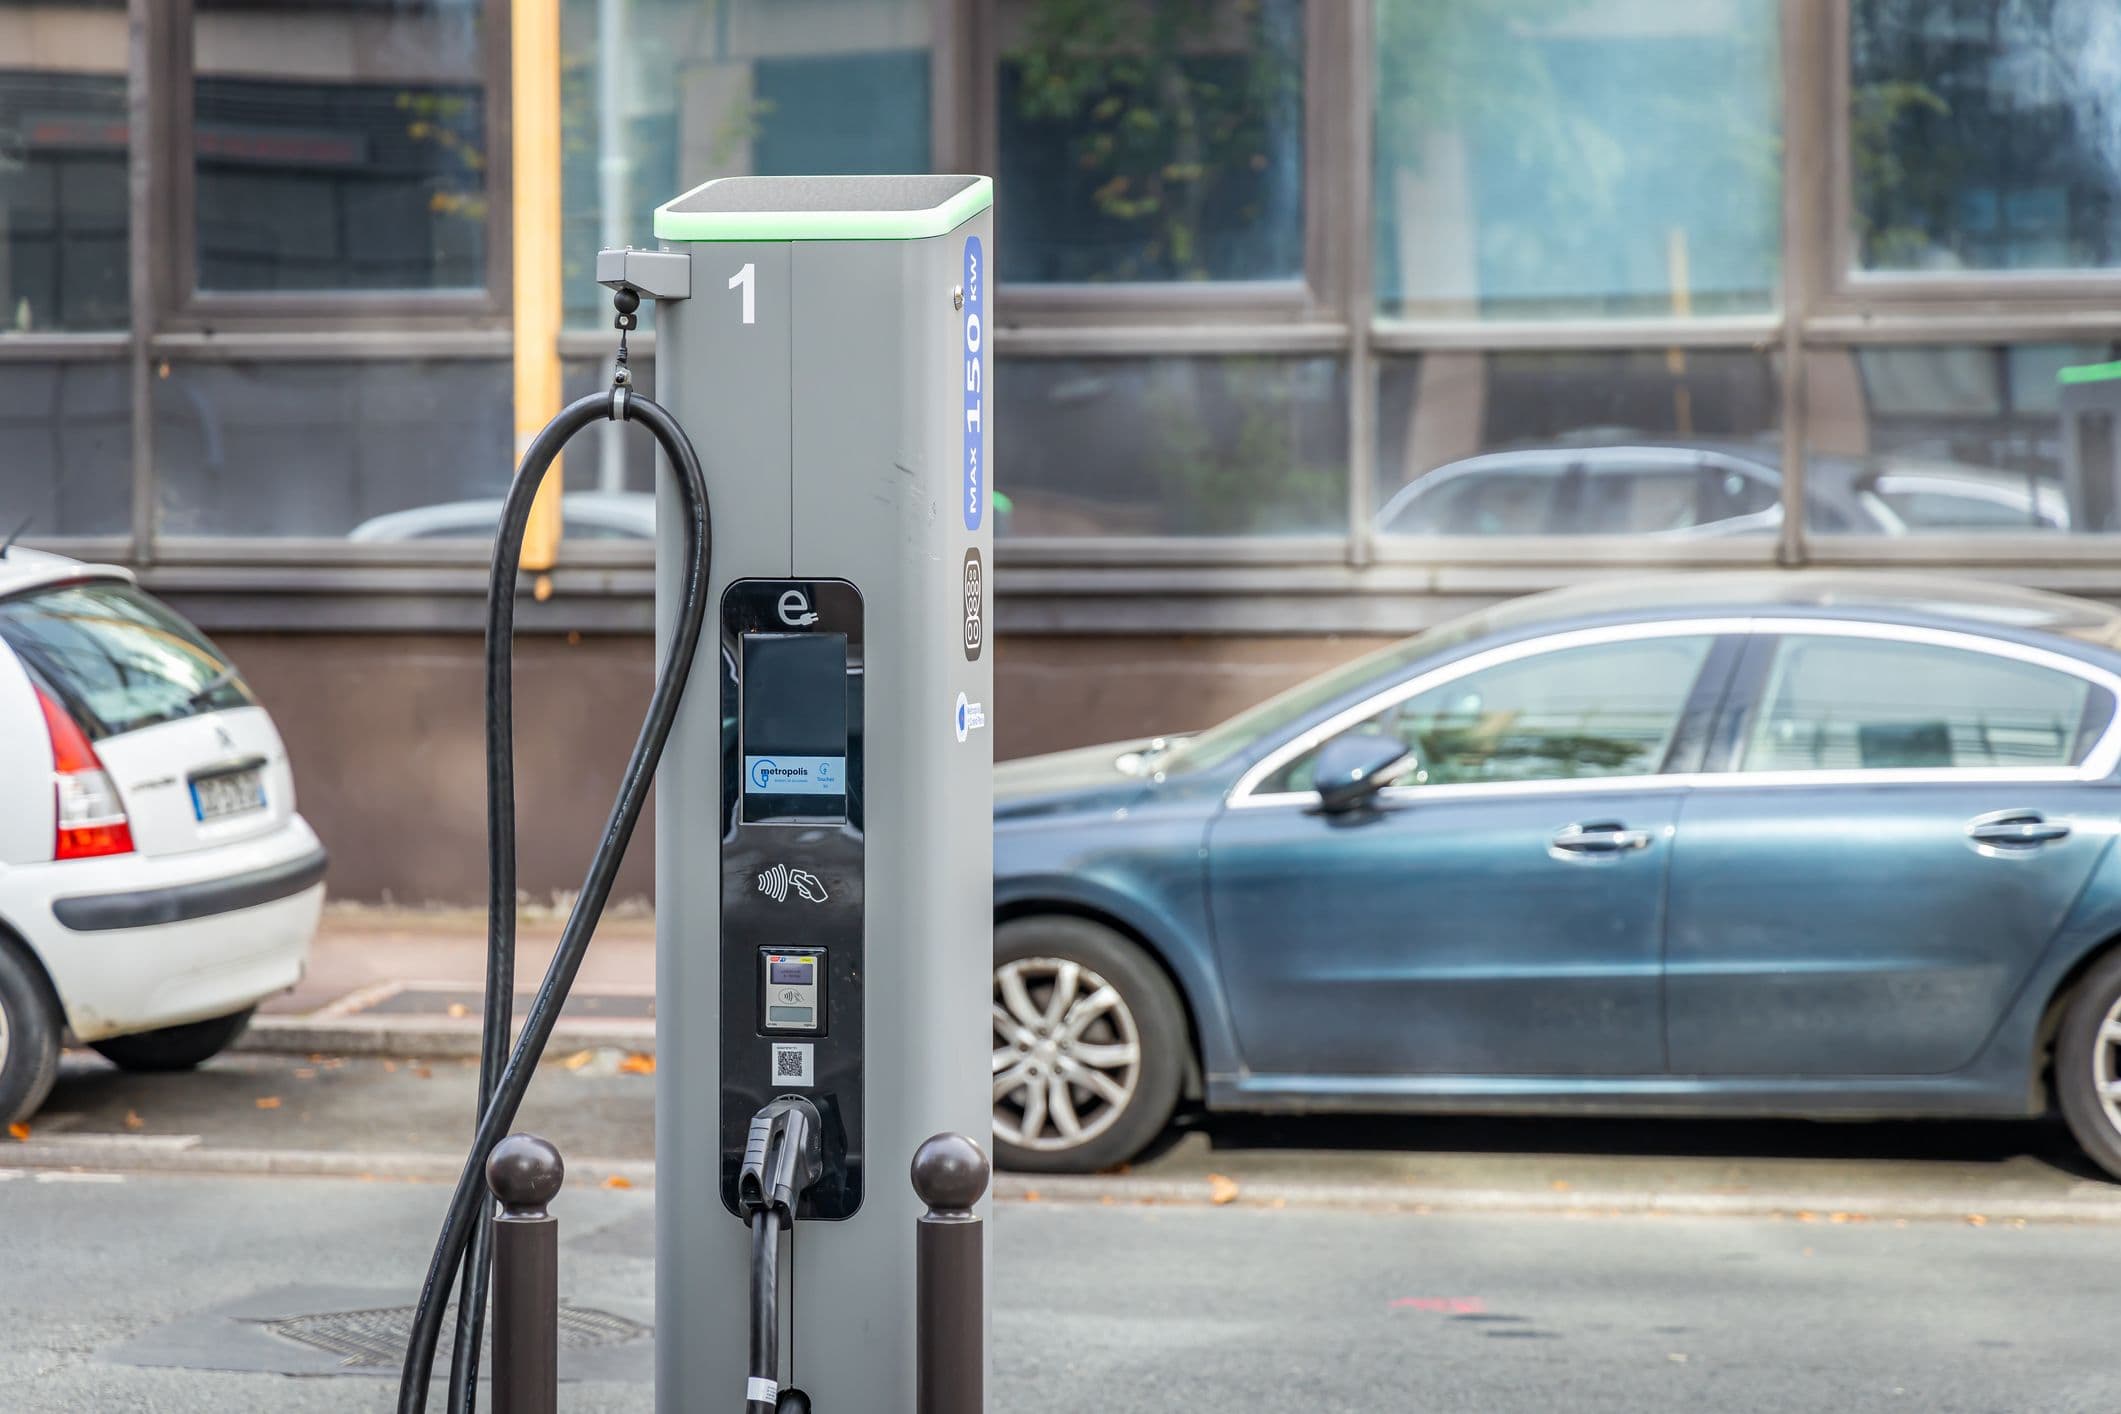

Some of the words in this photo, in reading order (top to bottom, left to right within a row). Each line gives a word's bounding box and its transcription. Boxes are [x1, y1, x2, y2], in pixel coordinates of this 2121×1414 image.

[728, 263, 755, 324] 1
[966, 313, 980, 432] 150
[969, 447, 977, 514] MAX
[760, 767, 808, 777] metropolis
